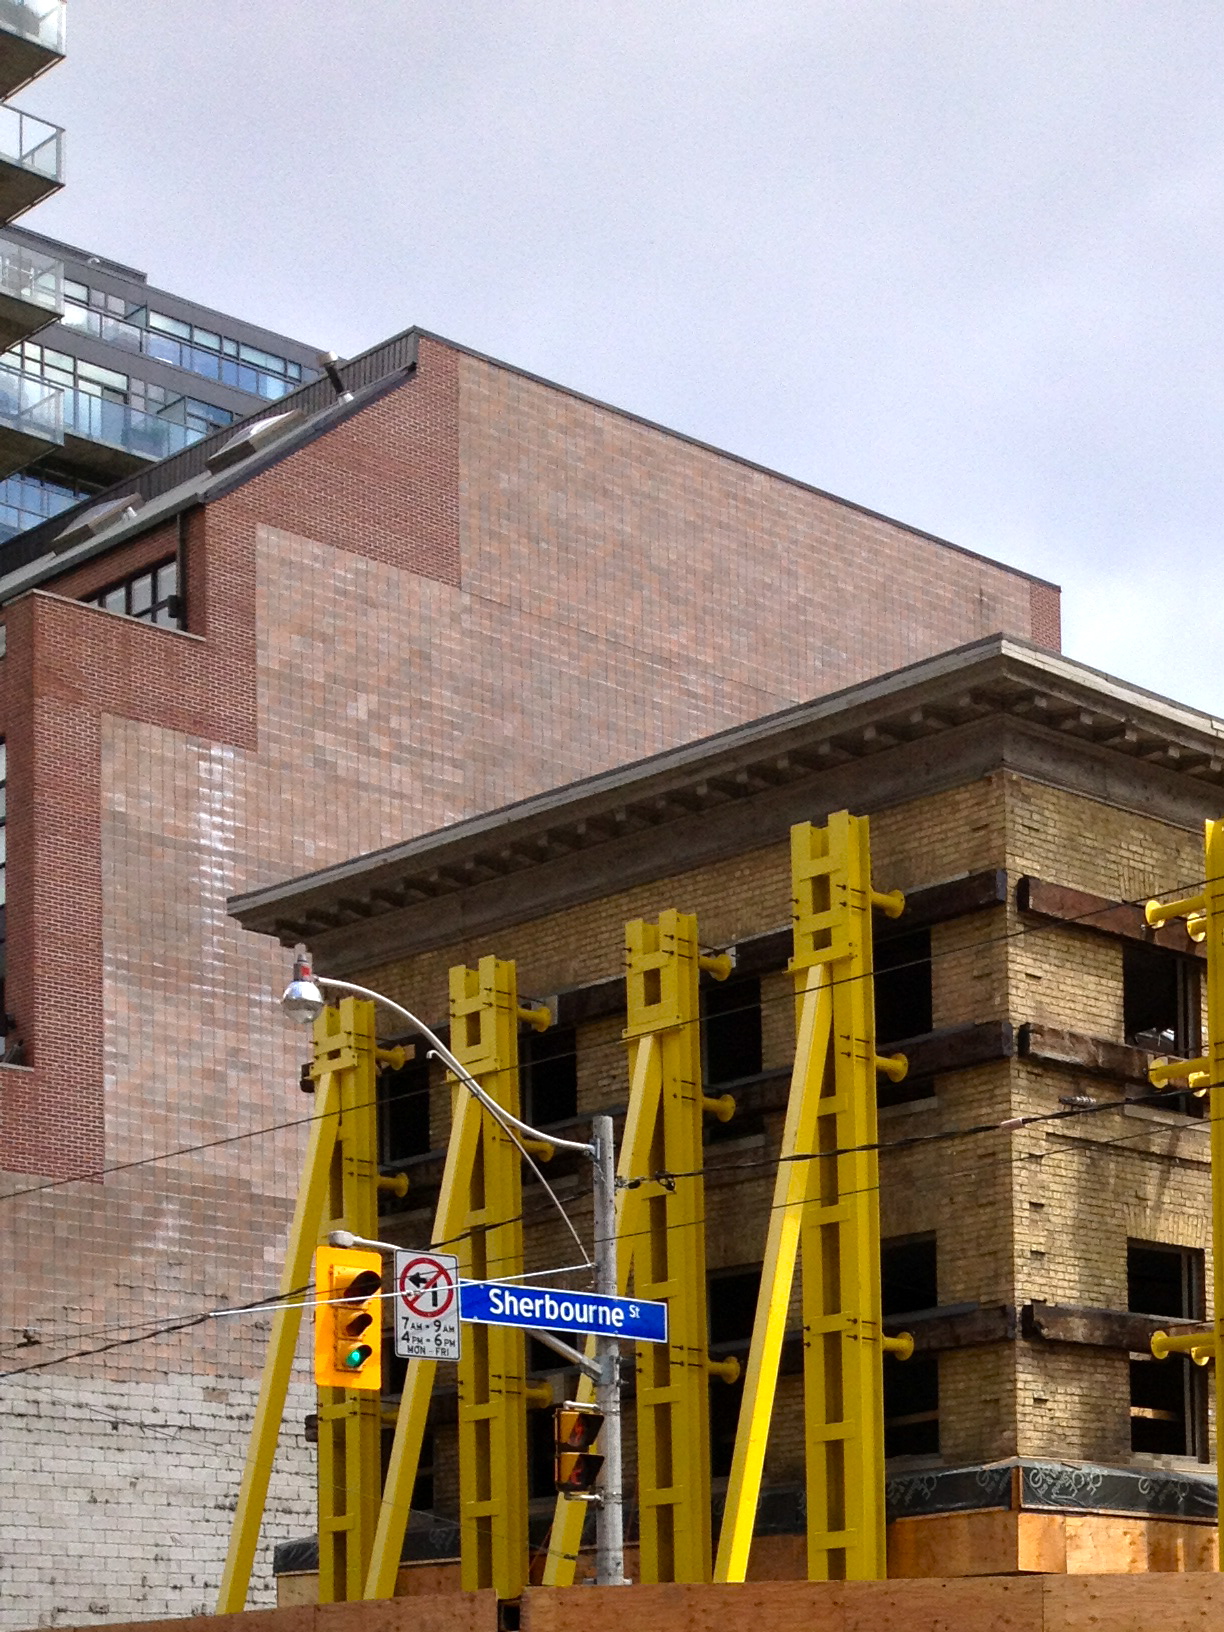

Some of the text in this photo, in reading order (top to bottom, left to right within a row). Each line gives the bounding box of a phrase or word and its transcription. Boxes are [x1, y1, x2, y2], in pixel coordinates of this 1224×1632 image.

[488, 1288, 641, 1328] Sherbourne St
[401, 1316, 409, 1330] 7
[433, 1319, 442, 1333] 9
[443, 1325, 455, 1333] AM
[401, 1330, 410, 1343] 4
[434, 1333, 443, 1347] 6
[444, 1338, 456, 1348] PM
[407, 1344, 426, 1355] MON
[435, 1347, 450, 1357] FRI
